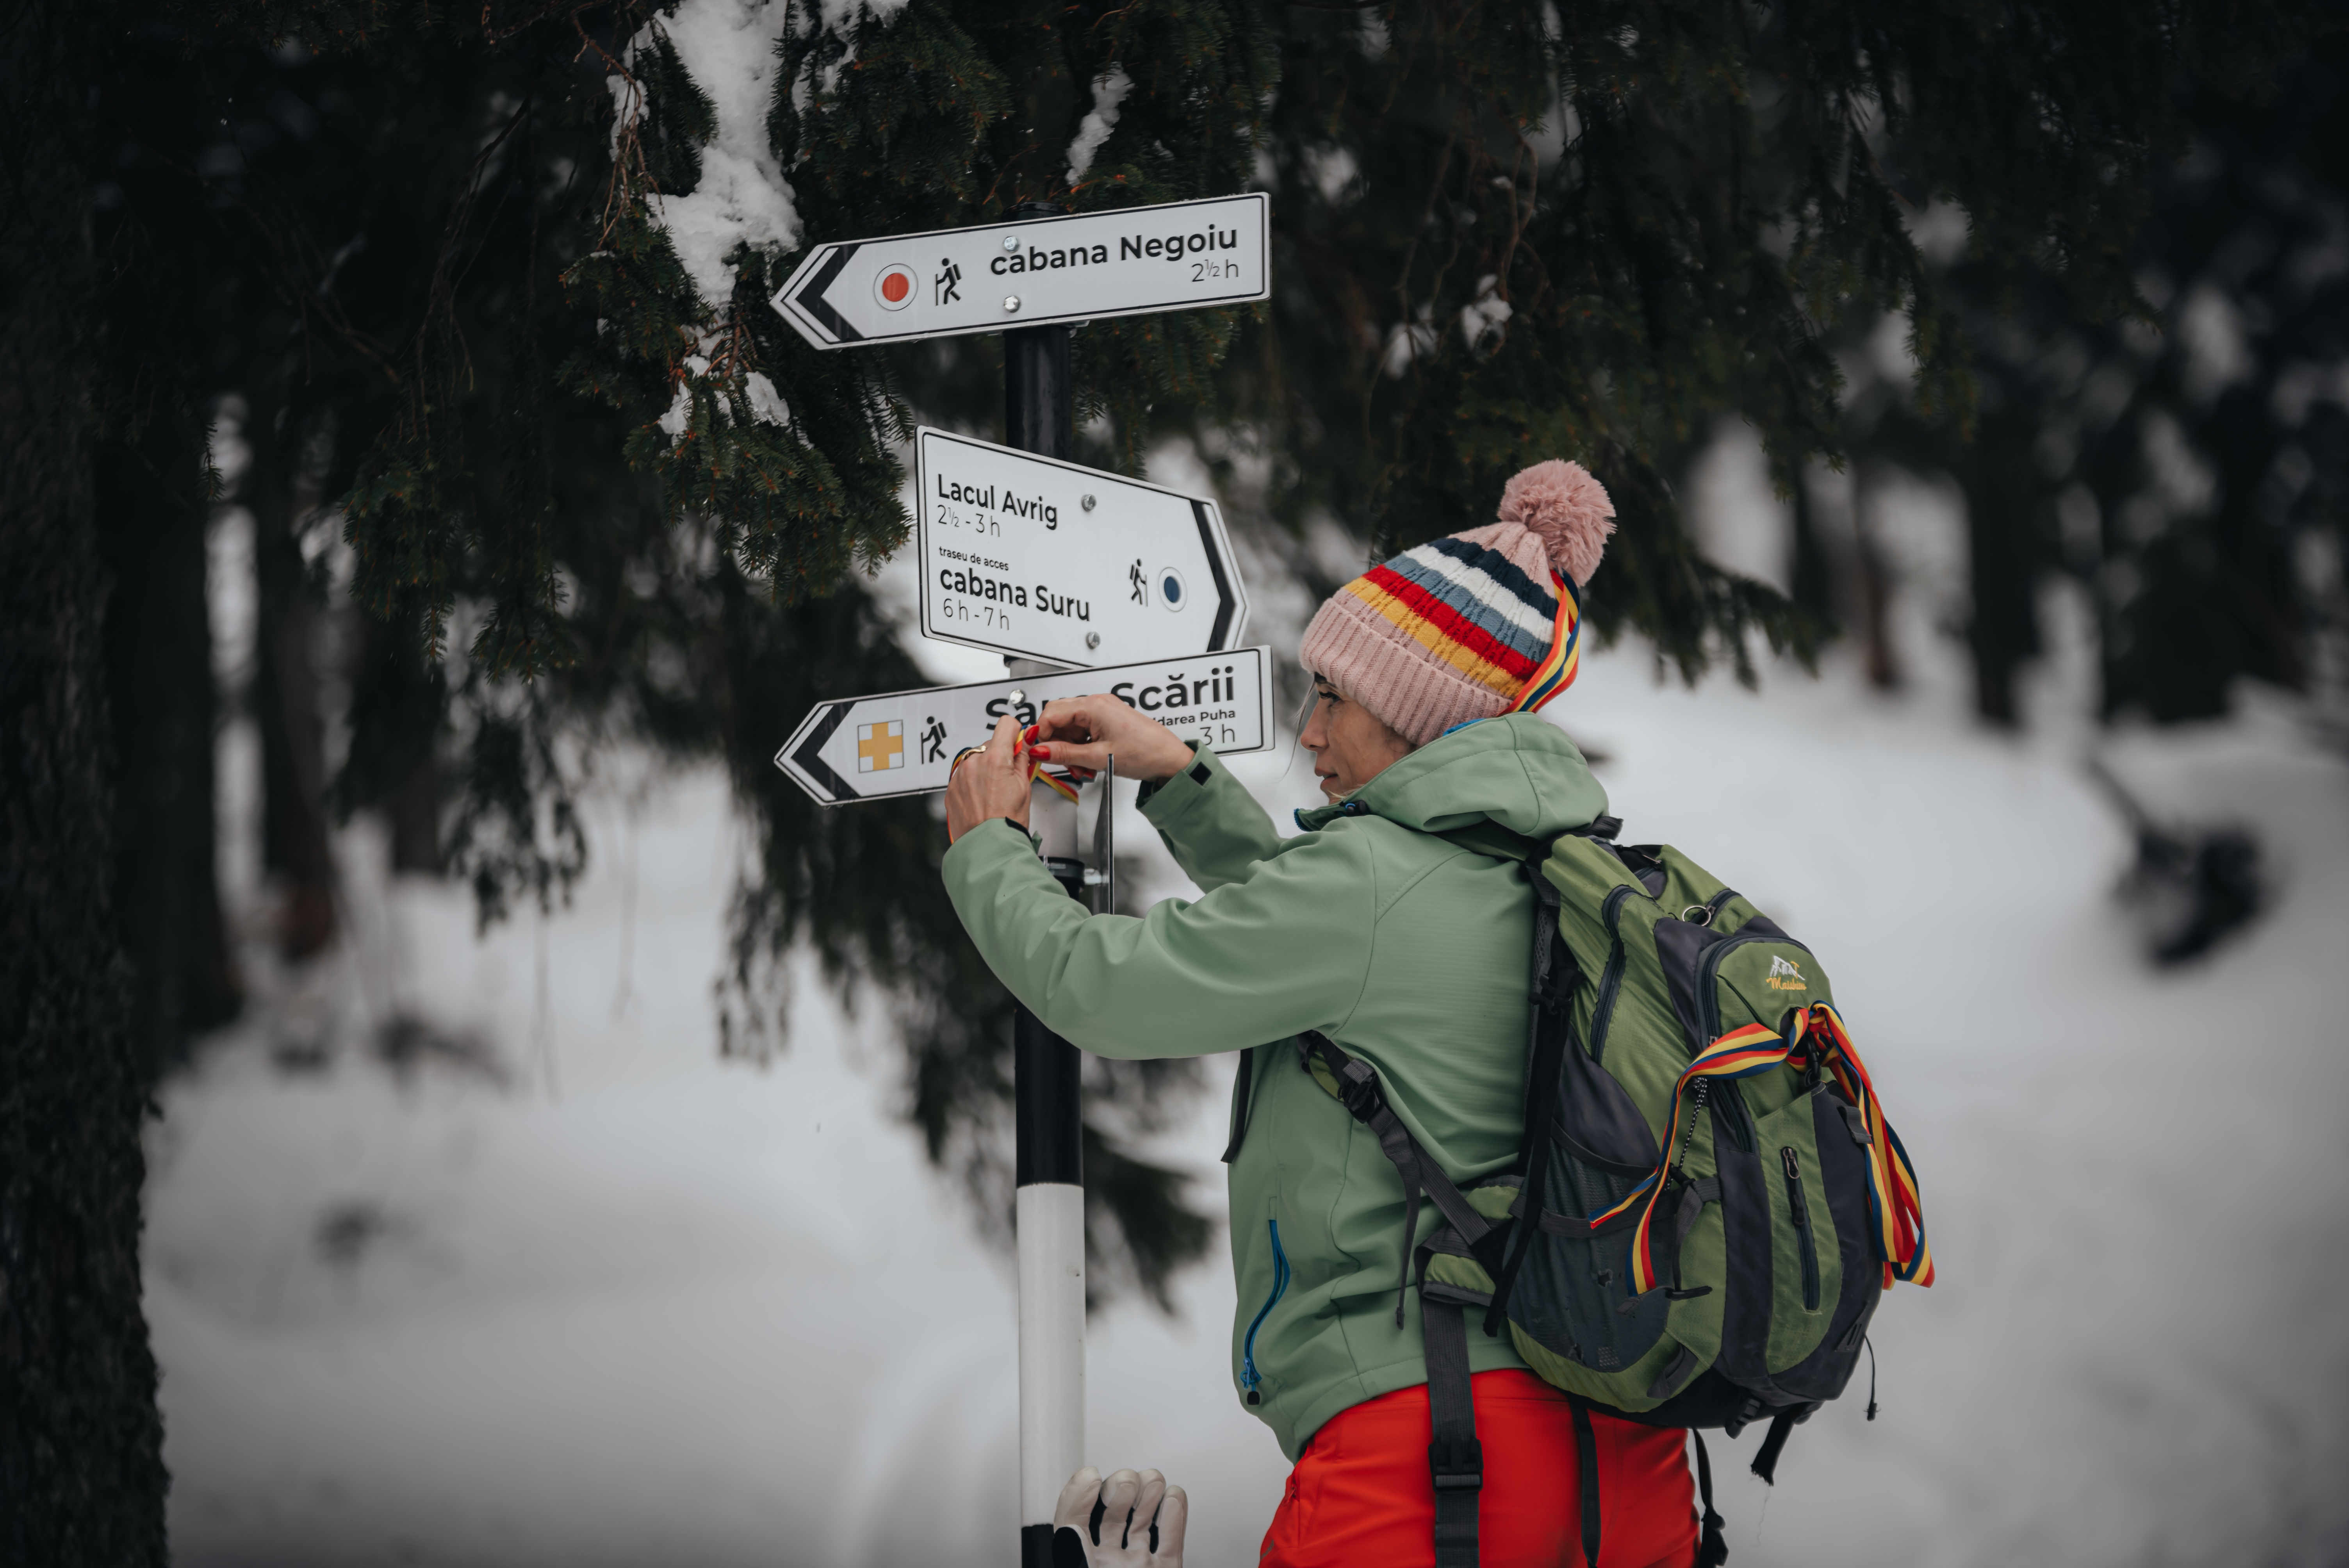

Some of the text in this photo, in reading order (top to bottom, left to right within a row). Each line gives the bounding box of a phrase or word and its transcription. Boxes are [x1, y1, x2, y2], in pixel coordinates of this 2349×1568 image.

[990, 224, 1237, 275] cabana Negoiu
[1226, 259, 1239, 278] h
[938, 474, 1058, 531] Lacul Avrig
[976, 513, 985, 533] 3
[990, 515, 1000, 537] h
[939, 546, 1009, 571] traseu de acces
[940, 567, 1090, 622] cabana Suru
[943, 598, 953, 618] 6
[959, 599, 969, 622] h
[984, 606, 994, 626] 7
[1000, 608, 1010, 631] h
[1110, 666, 1234, 711] Scării
[1200, 709, 1236, 722] Puha
[1199, 723, 1236, 746] 3 h
